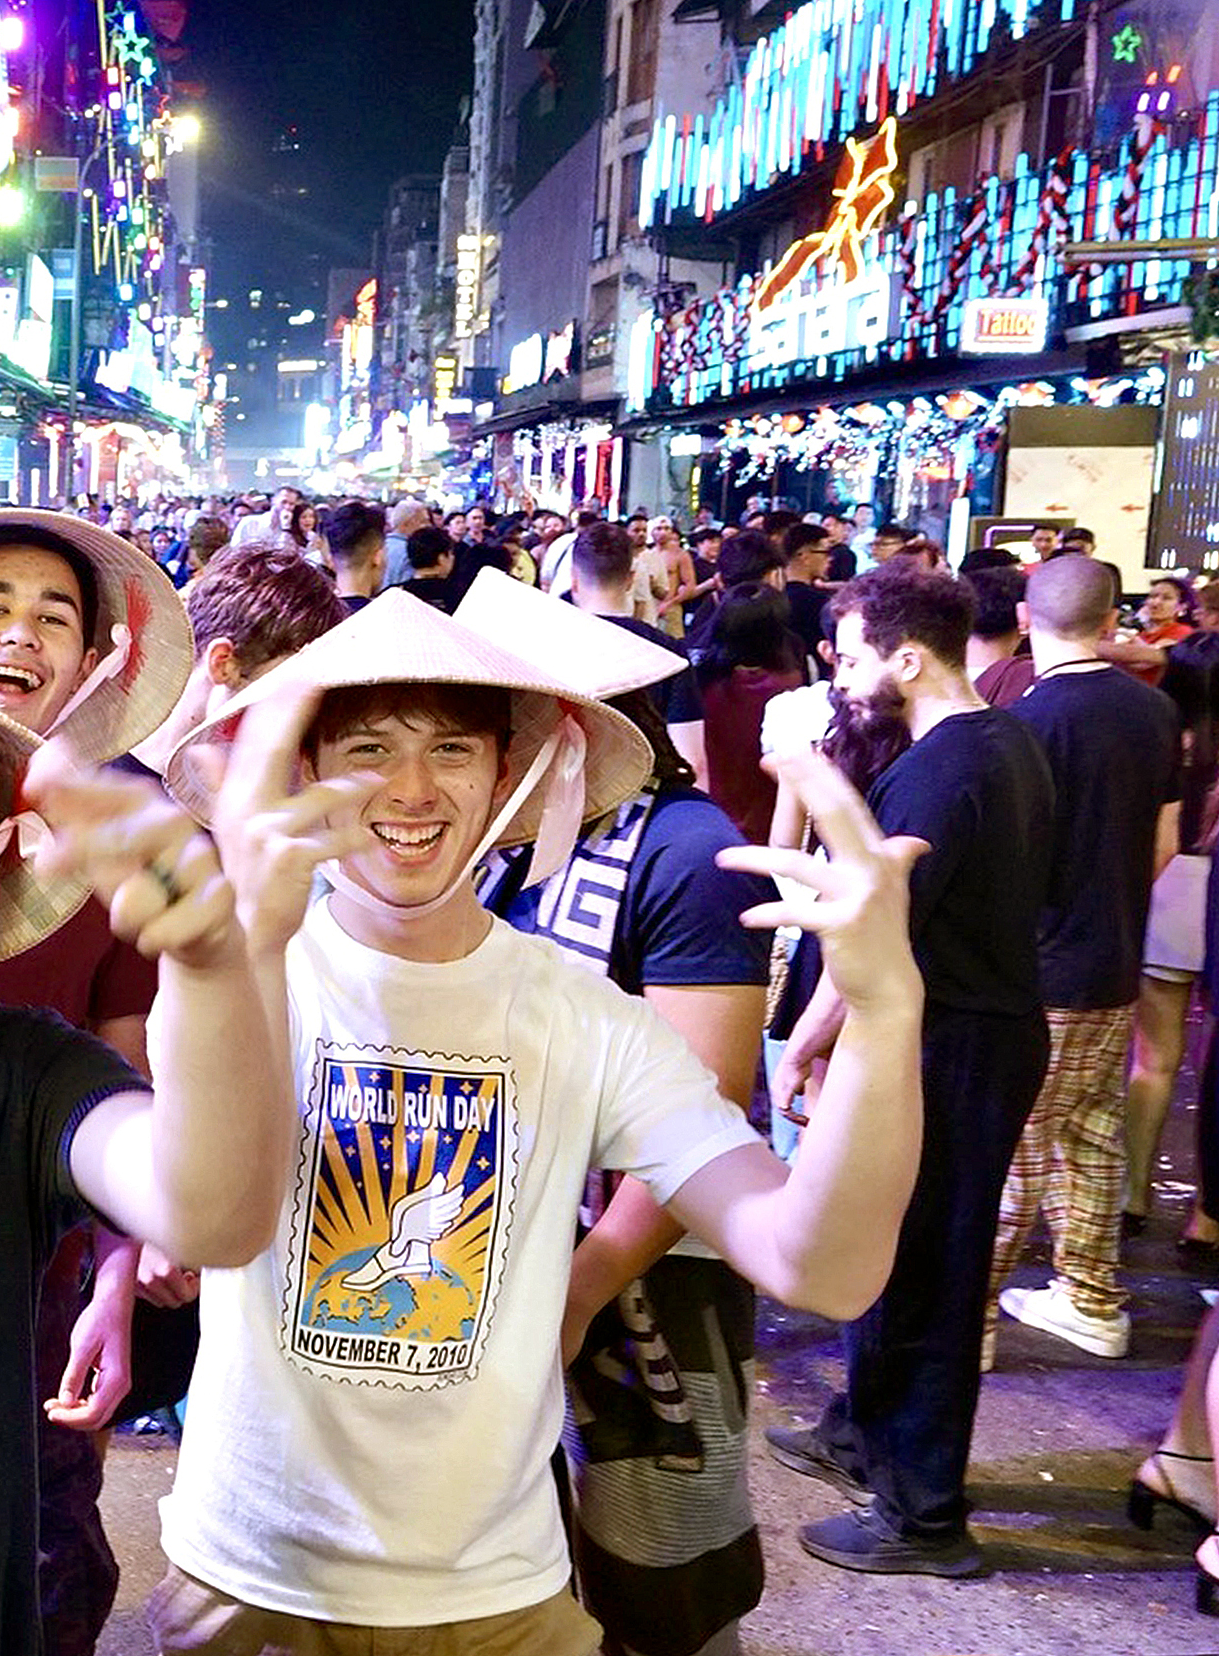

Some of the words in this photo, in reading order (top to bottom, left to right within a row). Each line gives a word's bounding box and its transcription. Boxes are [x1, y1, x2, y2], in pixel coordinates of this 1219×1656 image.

[980, 309, 1036, 335] Tattoo
[331, 1084, 398, 1125] WORLD
[404, 1091, 447, 1129] RUN
[454, 1096, 495, 1132] DAY
[298, 1329, 401, 1366] NOVEMBER
[407, 1345, 421, 1373] 7,
[427, 1344, 468, 1368] 2010
